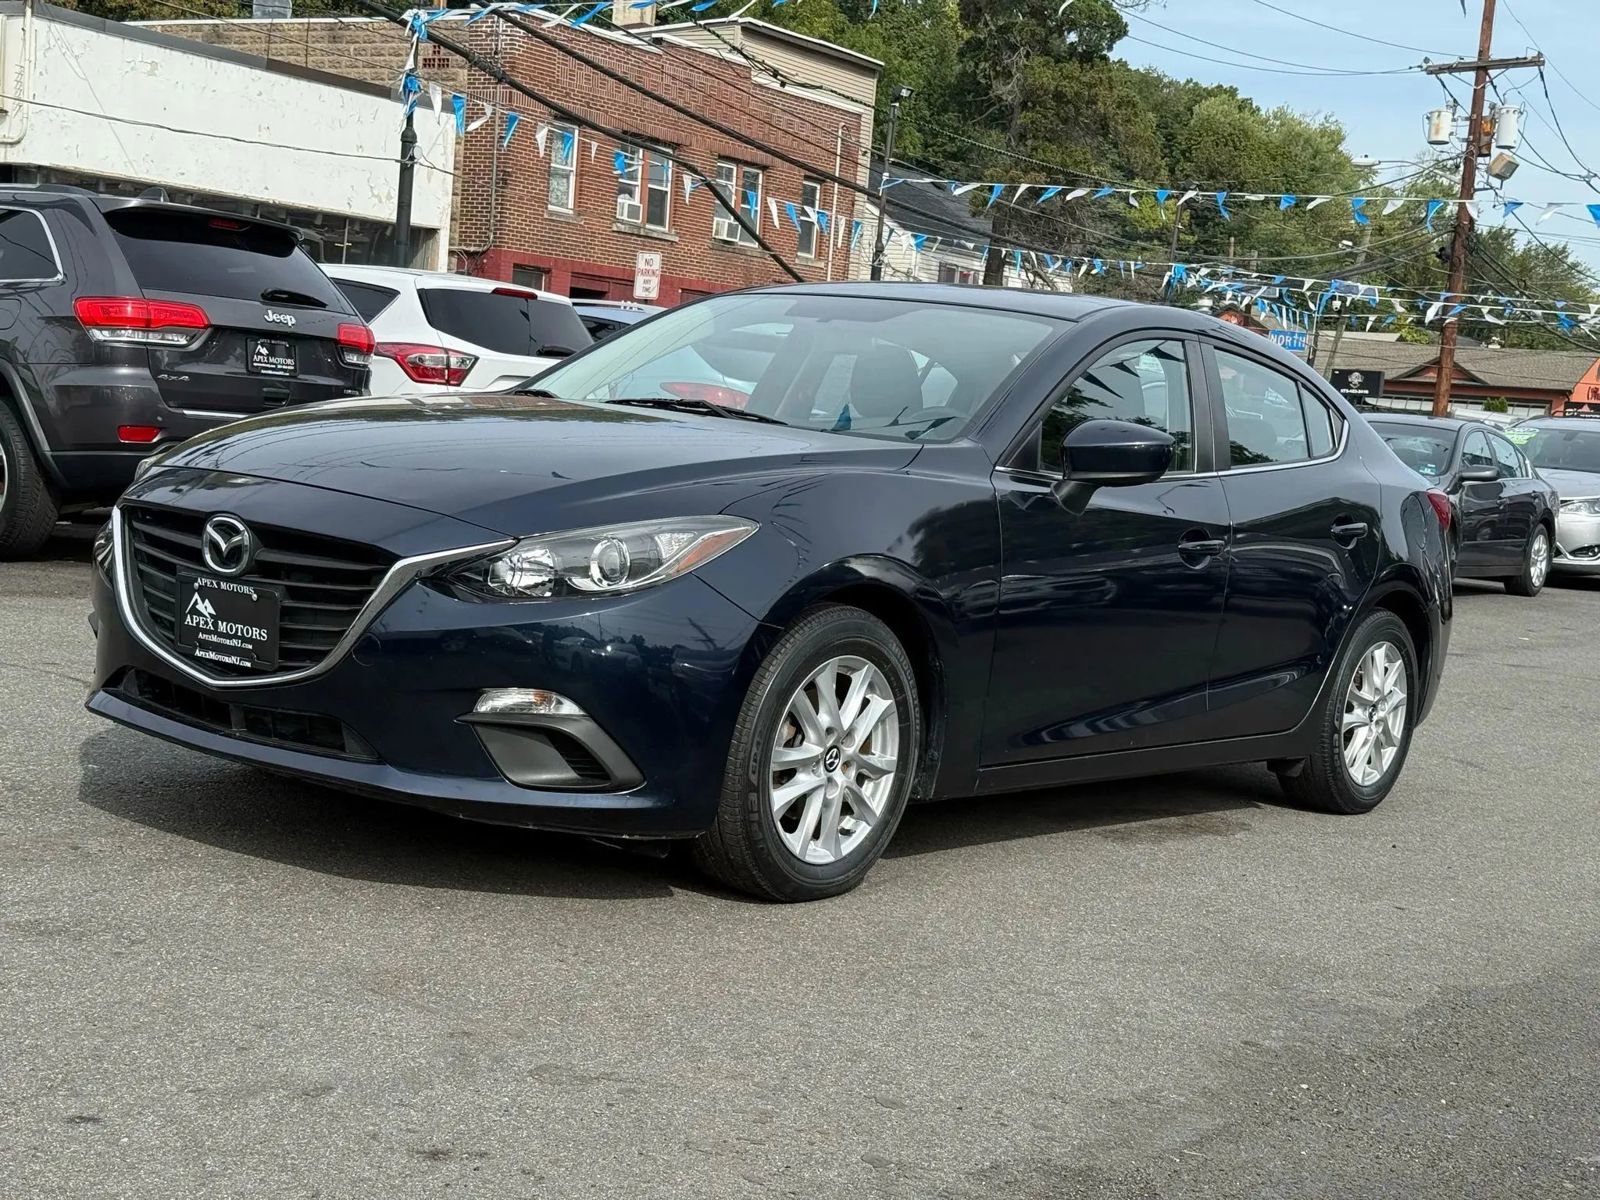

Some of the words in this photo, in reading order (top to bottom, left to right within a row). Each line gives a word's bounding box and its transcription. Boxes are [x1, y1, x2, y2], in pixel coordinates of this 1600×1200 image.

[644, 258, 654, 267] NO
[637, 267, 659, 278] PARKING
[264, 309, 296, 326] Jeep
[1270, 334, 1305, 347] NORTH
[253, 354, 268, 363] APEX
[269, 356, 295, 366] MOTORS
[197, 577, 218, 589] APEX
[220, 581, 254, 595] MOTORS
[184, 614, 215, 631] APEX
[217, 620, 268, 641] MOTORS
